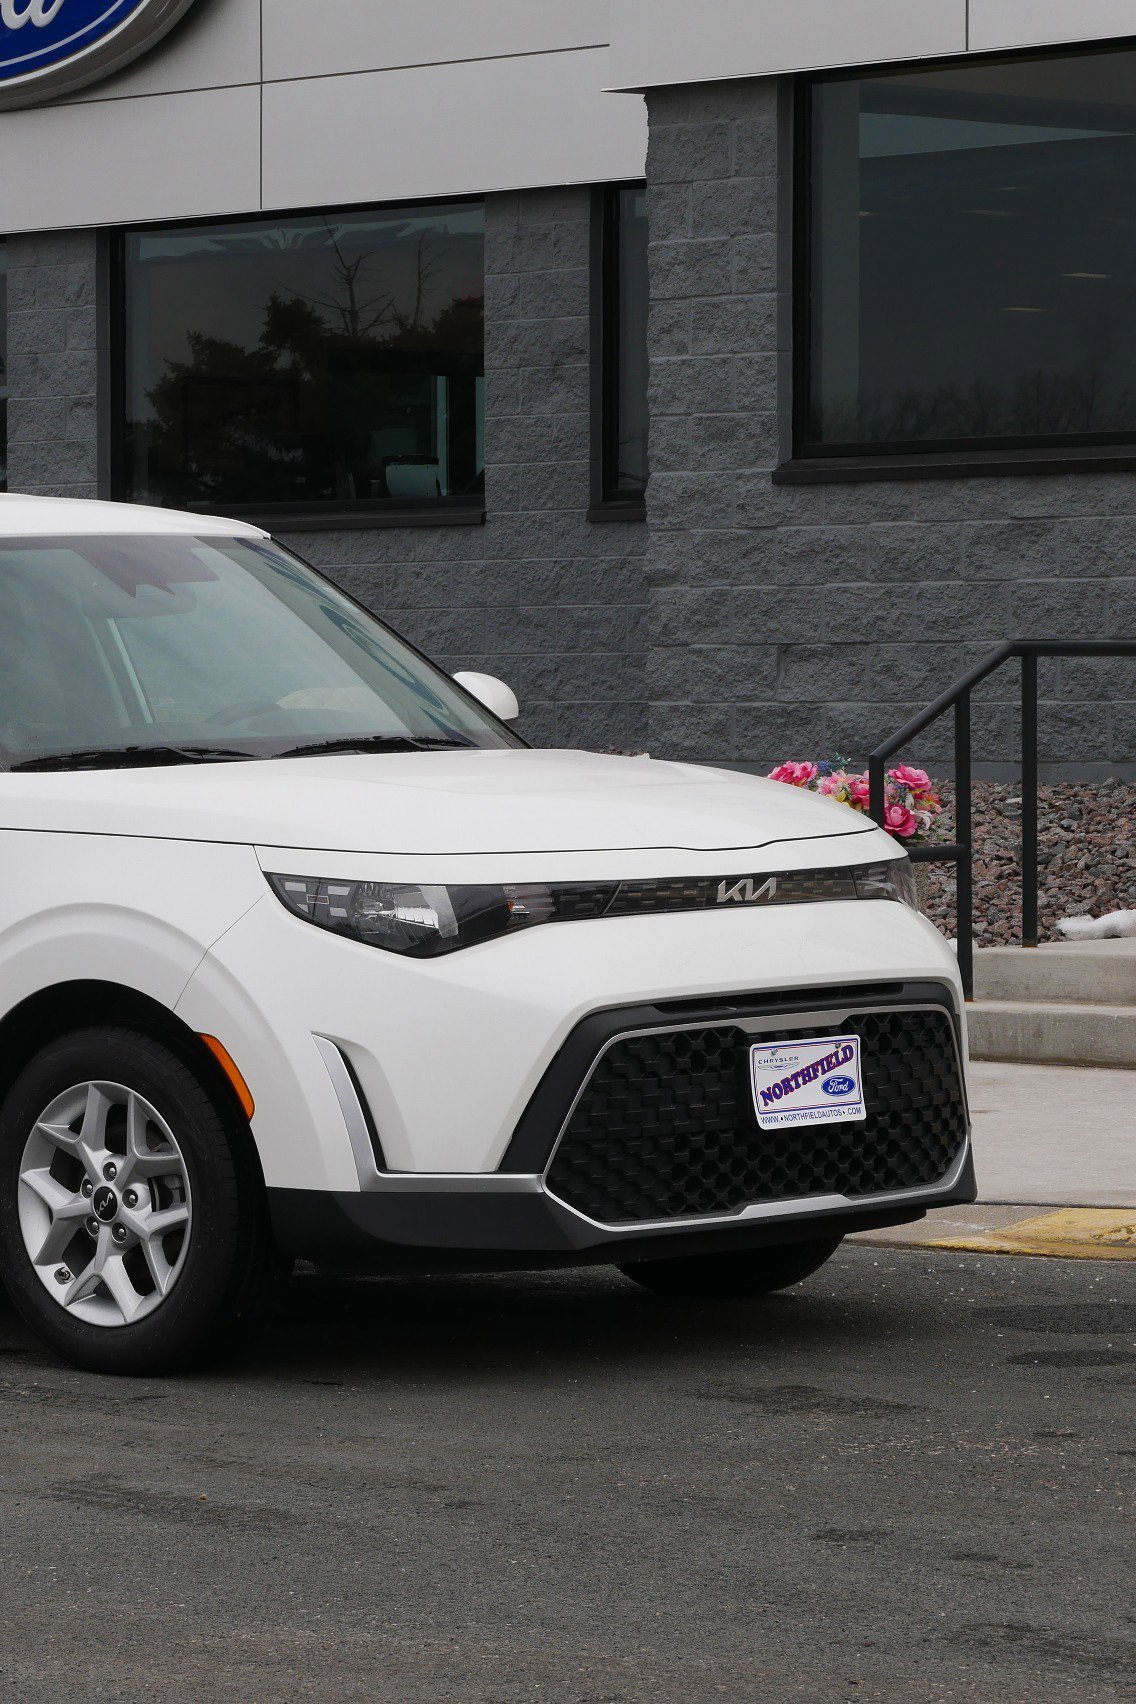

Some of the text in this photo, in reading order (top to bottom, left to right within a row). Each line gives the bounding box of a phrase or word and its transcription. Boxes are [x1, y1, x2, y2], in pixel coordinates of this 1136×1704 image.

[758, 1056, 799, 1065] CHRYSLER
[759, 1044, 854, 1107] NORTHFIELD
[828, 1078, 849, 1093] Ford
